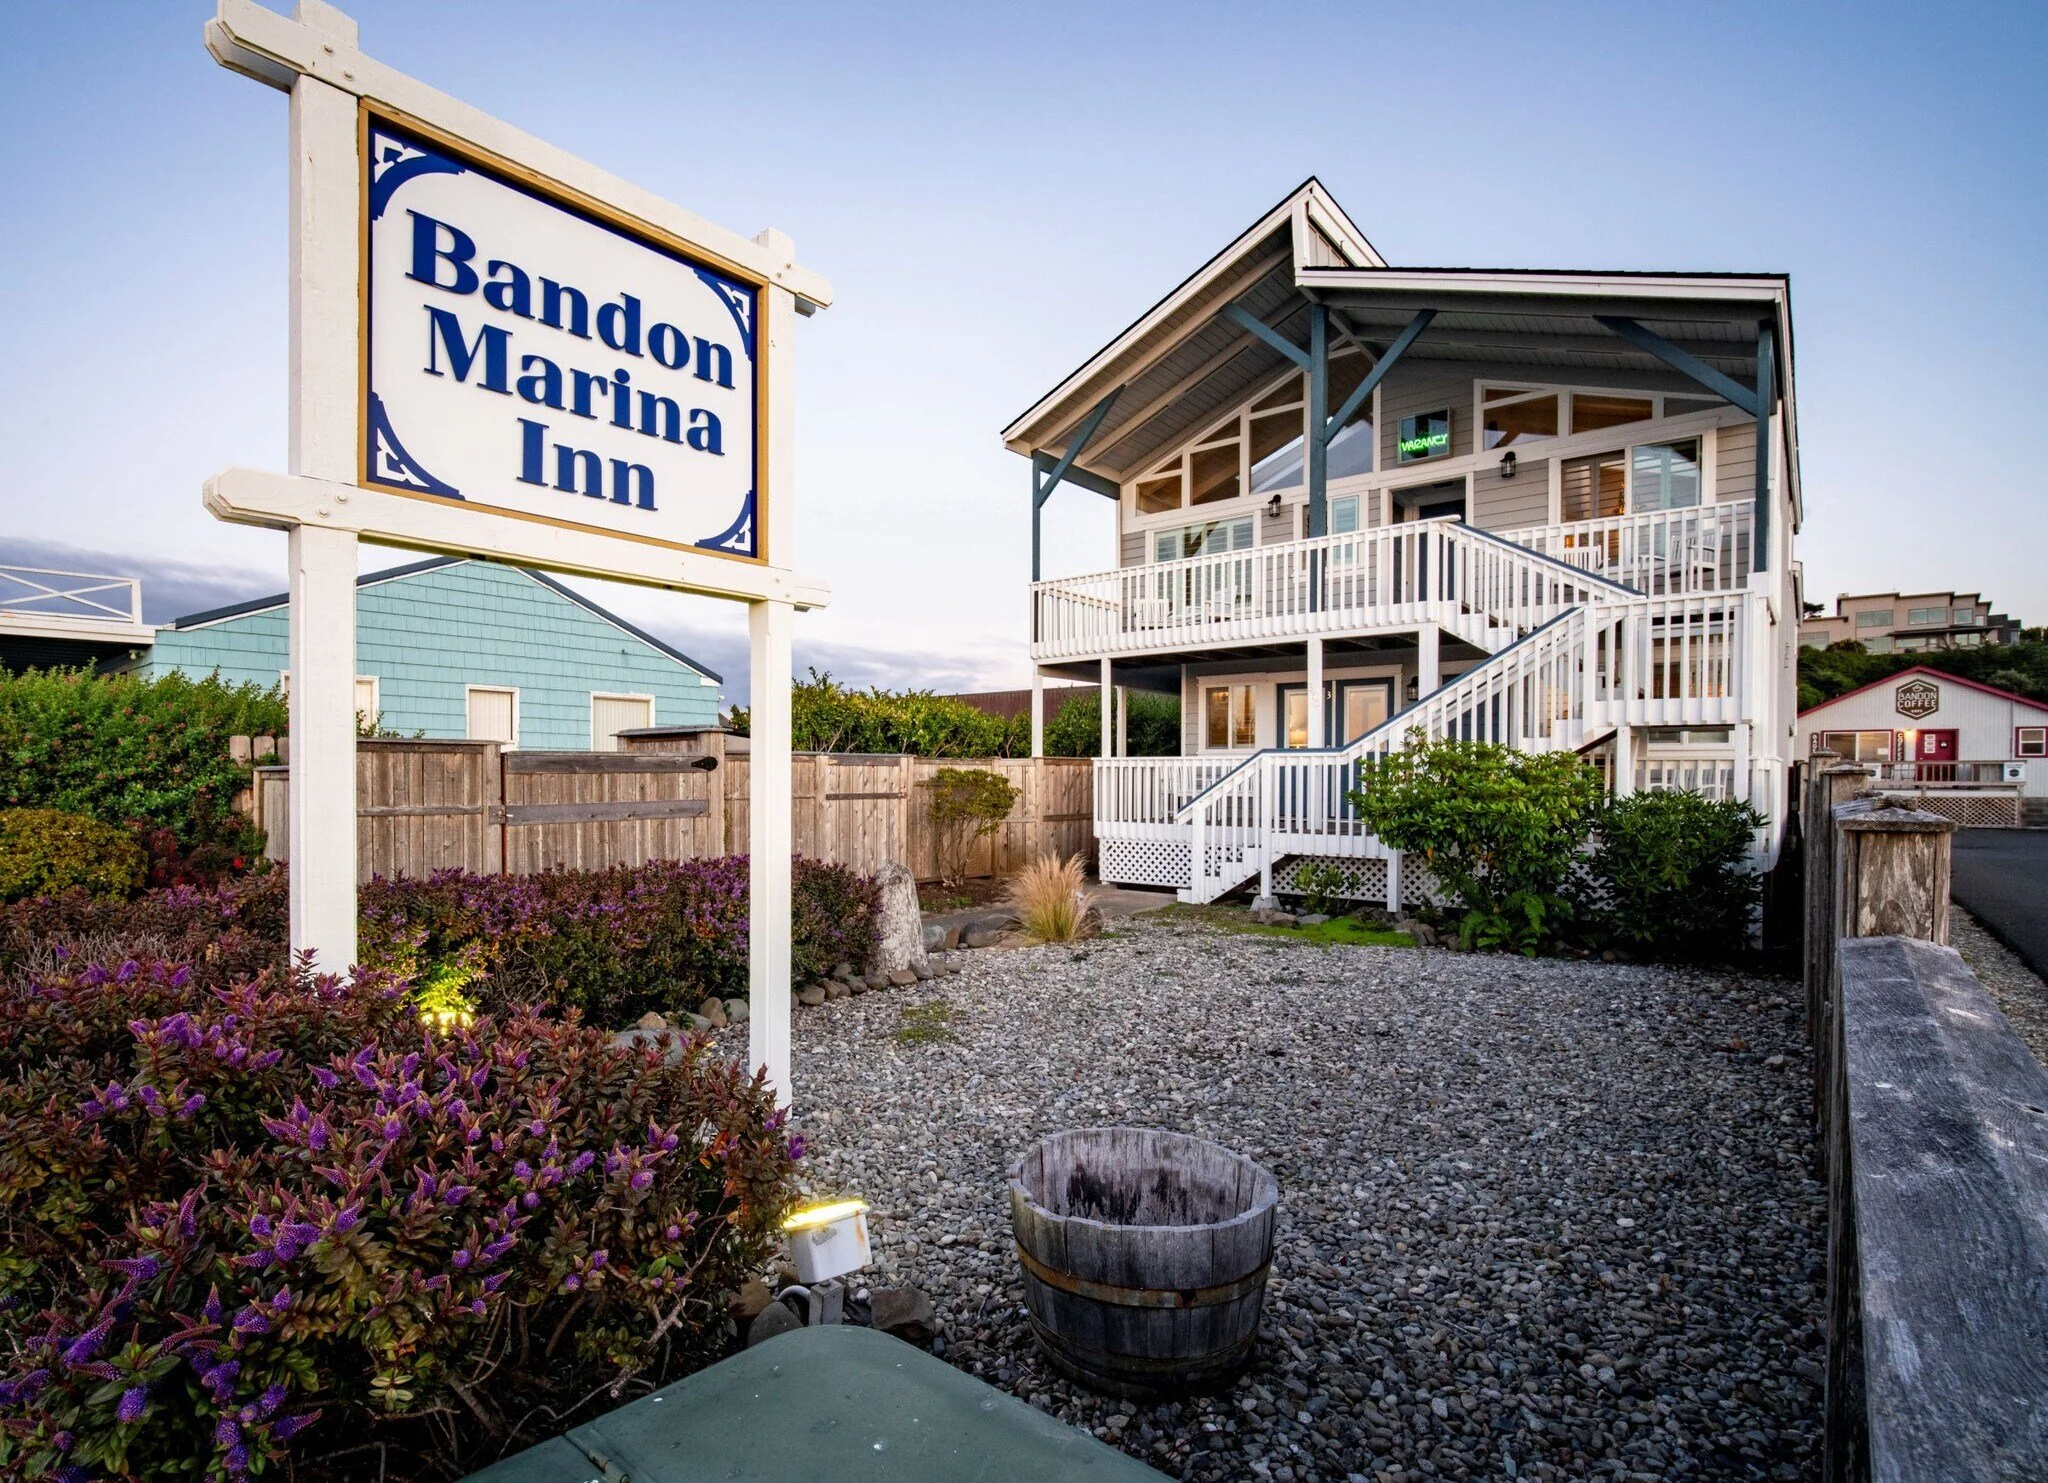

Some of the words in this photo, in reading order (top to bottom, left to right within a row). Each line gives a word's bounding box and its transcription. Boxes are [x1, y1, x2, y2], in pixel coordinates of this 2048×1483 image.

[405, 208, 736, 390] Bandon
[423, 304, 726, 456] Marina
[516, 416, 659, 512] Inn
[1401, 433, 1448, 452] VACANCY
[1897, 691, 1937, 701] BANDON
[1897, 700, 1937, 708] COFFEE
